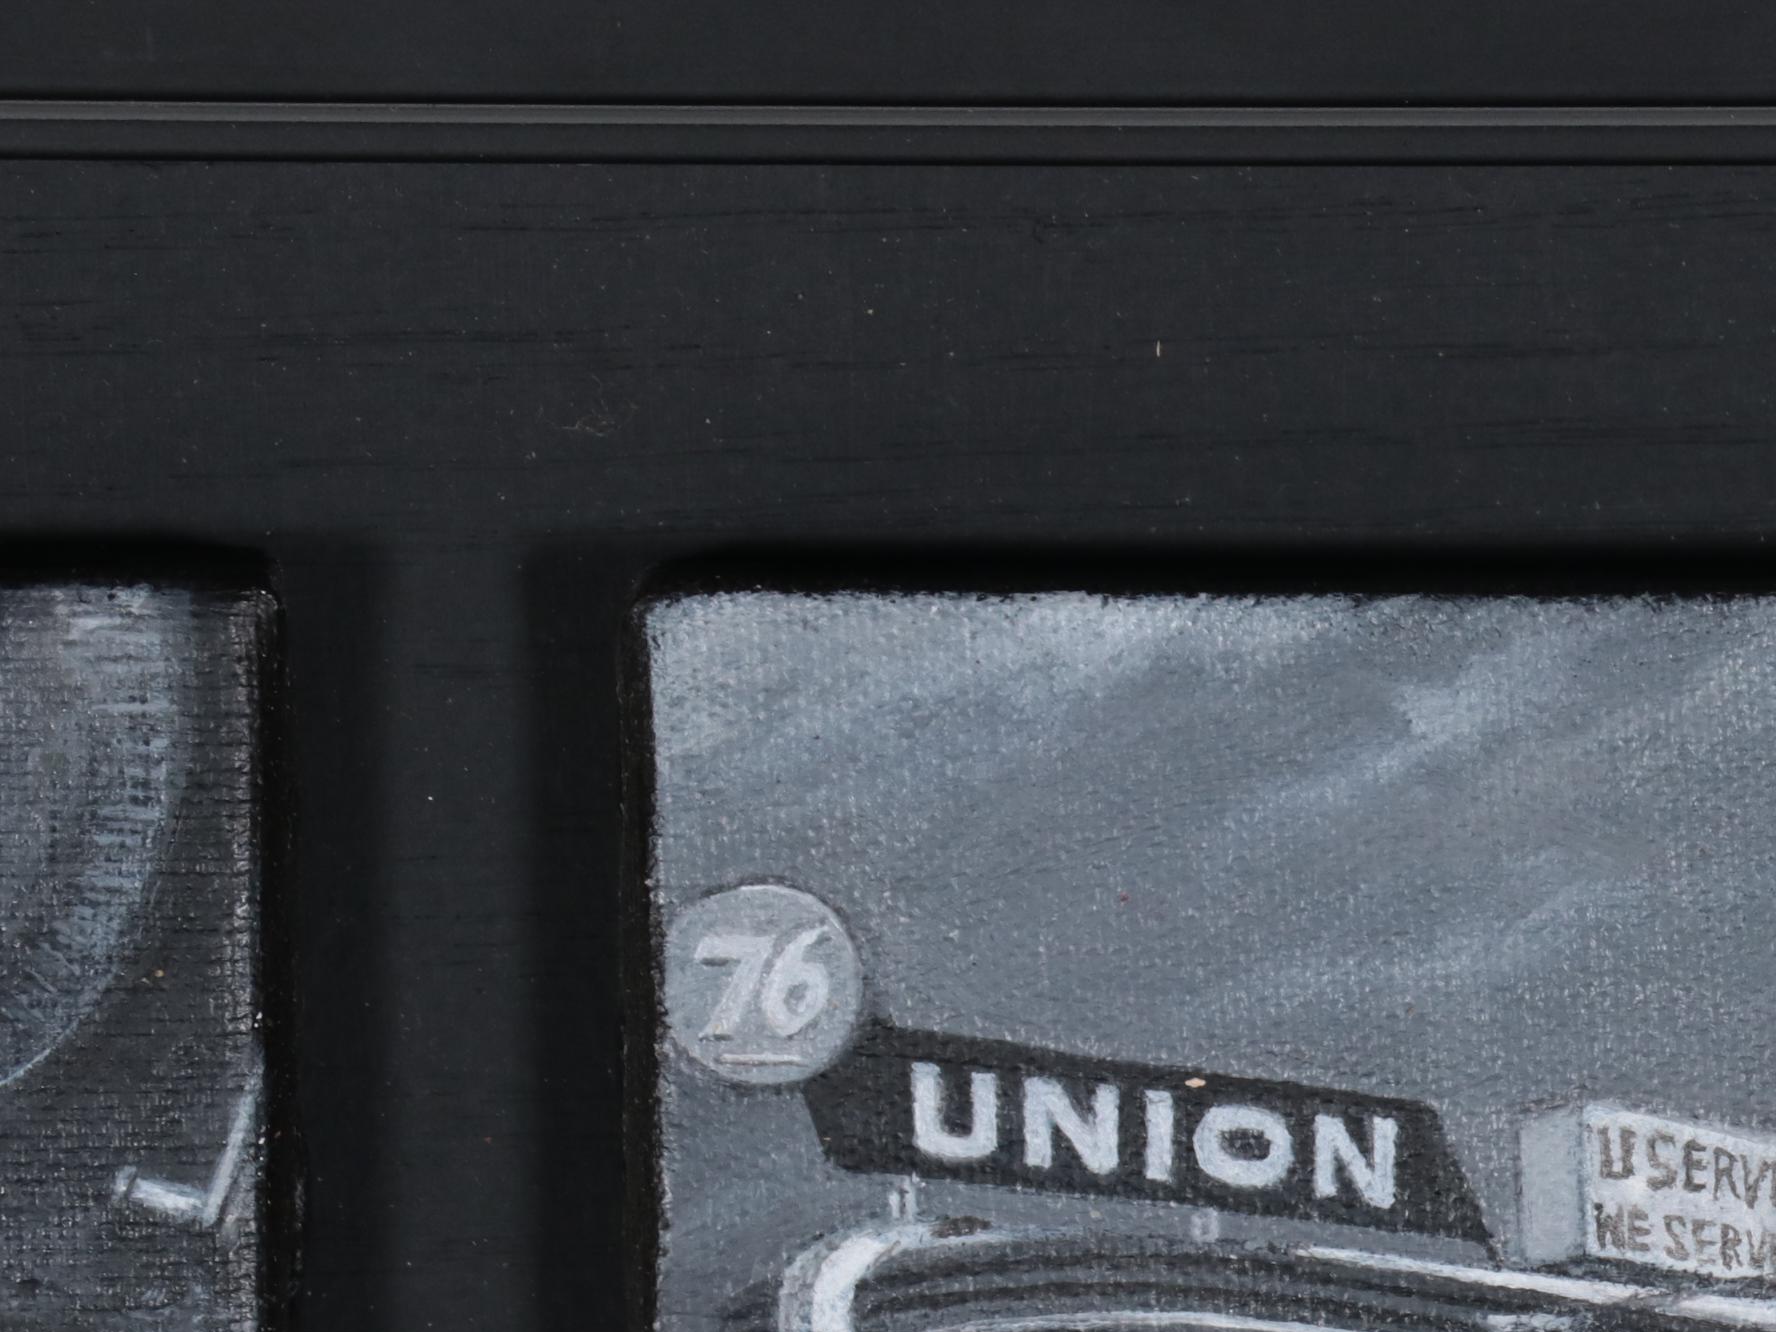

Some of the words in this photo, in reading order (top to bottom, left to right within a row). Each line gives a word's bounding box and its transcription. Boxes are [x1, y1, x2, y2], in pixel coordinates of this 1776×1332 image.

[693, 924, 829, 1038] 76
[910, 1060, 1398, 1209] UNION
[1597, 1124, 1637, 1180] U
